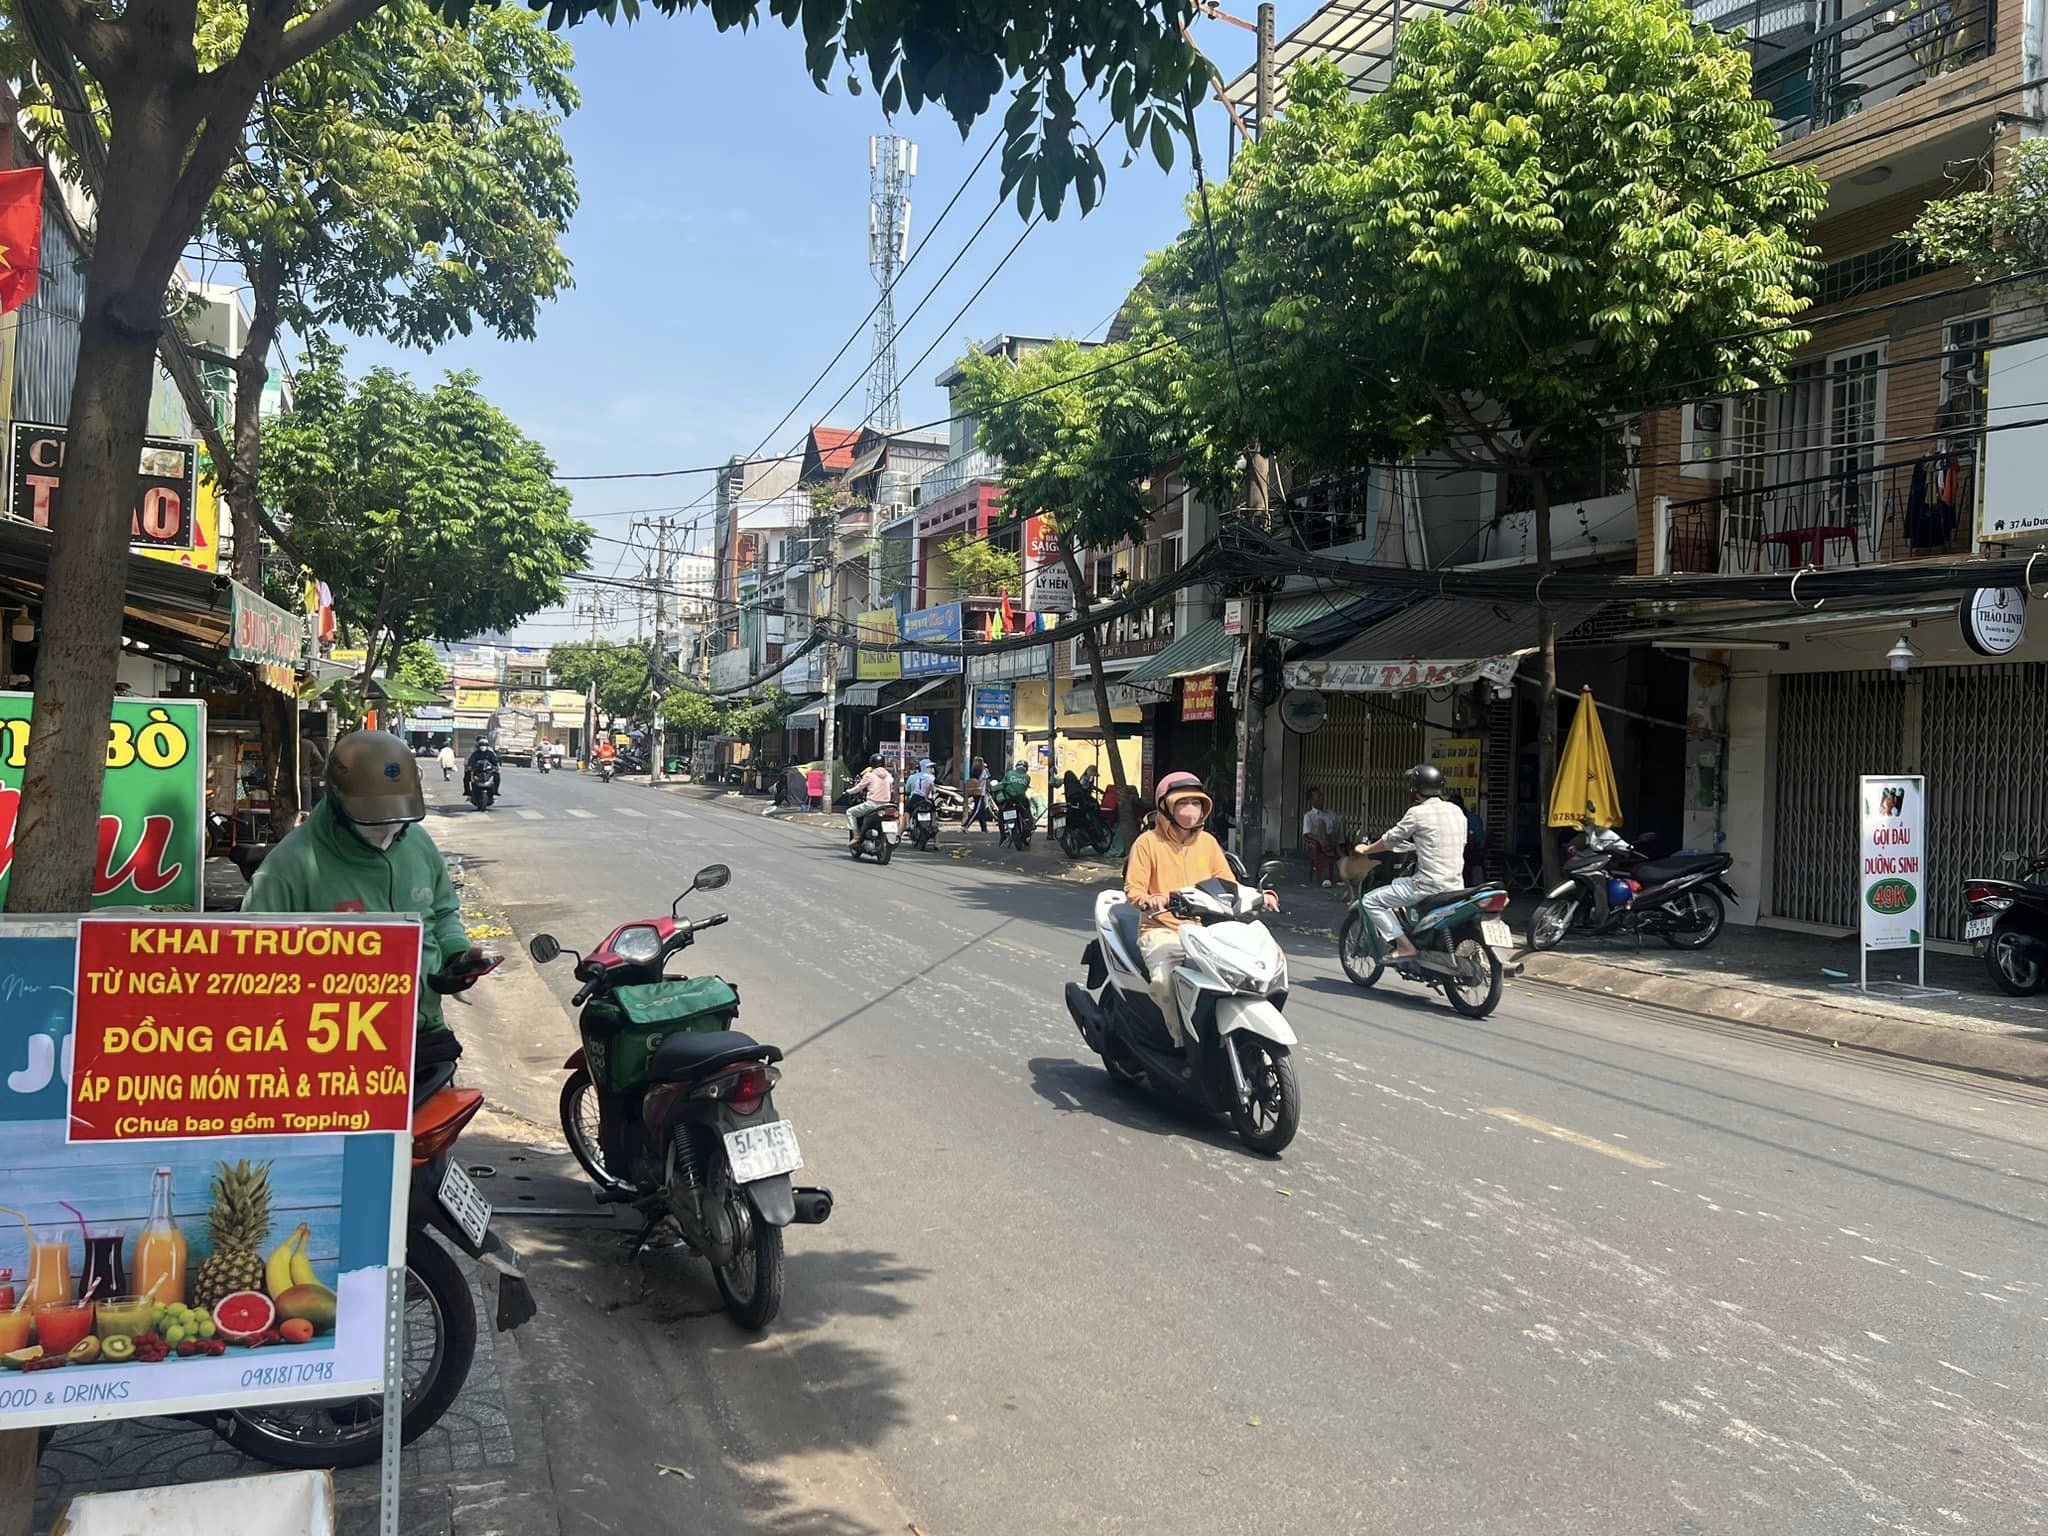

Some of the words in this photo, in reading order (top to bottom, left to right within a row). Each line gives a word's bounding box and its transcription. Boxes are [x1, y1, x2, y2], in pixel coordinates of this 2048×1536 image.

[2009, 520, 2020, 530] 37
[1979, 609, 2002, 623] THẢO
[2003, 613, 2022, 624] LINH
[105, 707, 188, 769] BÒ
[1865, 854, 1896, 875] DƯỠNG
[1898, 857, 1919, 874] SINH
[1873, 884, 1909, 909] 49K
[130, 928, 220, 954] KHAI
[230, 926, 382, 956] TRƯƠNG
[87, 966, 123, 995] TỪ
[128, 966, 200, 995] NGÀY
[206, 972, 301, 995] 27/02/23
[322, 972, 412, 995] 02/03/23
[103, 1015, 213, 1053] ĐỒNG
[225, 1018, 289, 1052] GIÁ
[306, 1000, 390, 1053] 5K
[8, 1033, 73, 1093] J
[78, 1069, 111, 1102] ÁP
[117, 1074, 182, 1106] DỤNG
[189, 1067, 240, 1101] MÓN
[246, 1067, 290, 1098] TRÀ
[296, 1074, 311, 1097] &
[317, 1065, 360, 1096] TRÀ
[365, 1064, 408, 1095] SỮA
[114, 1117, 179, 1137] (Chưa
[185, 1114, 225, 1132] bao
[230, 1110, 275, 1134] gồm
[281, 1110, 371, 1133] Topping)
[43, 1392, 55, 1405] &
[62, 1380, 131, 1404] DRINKS
